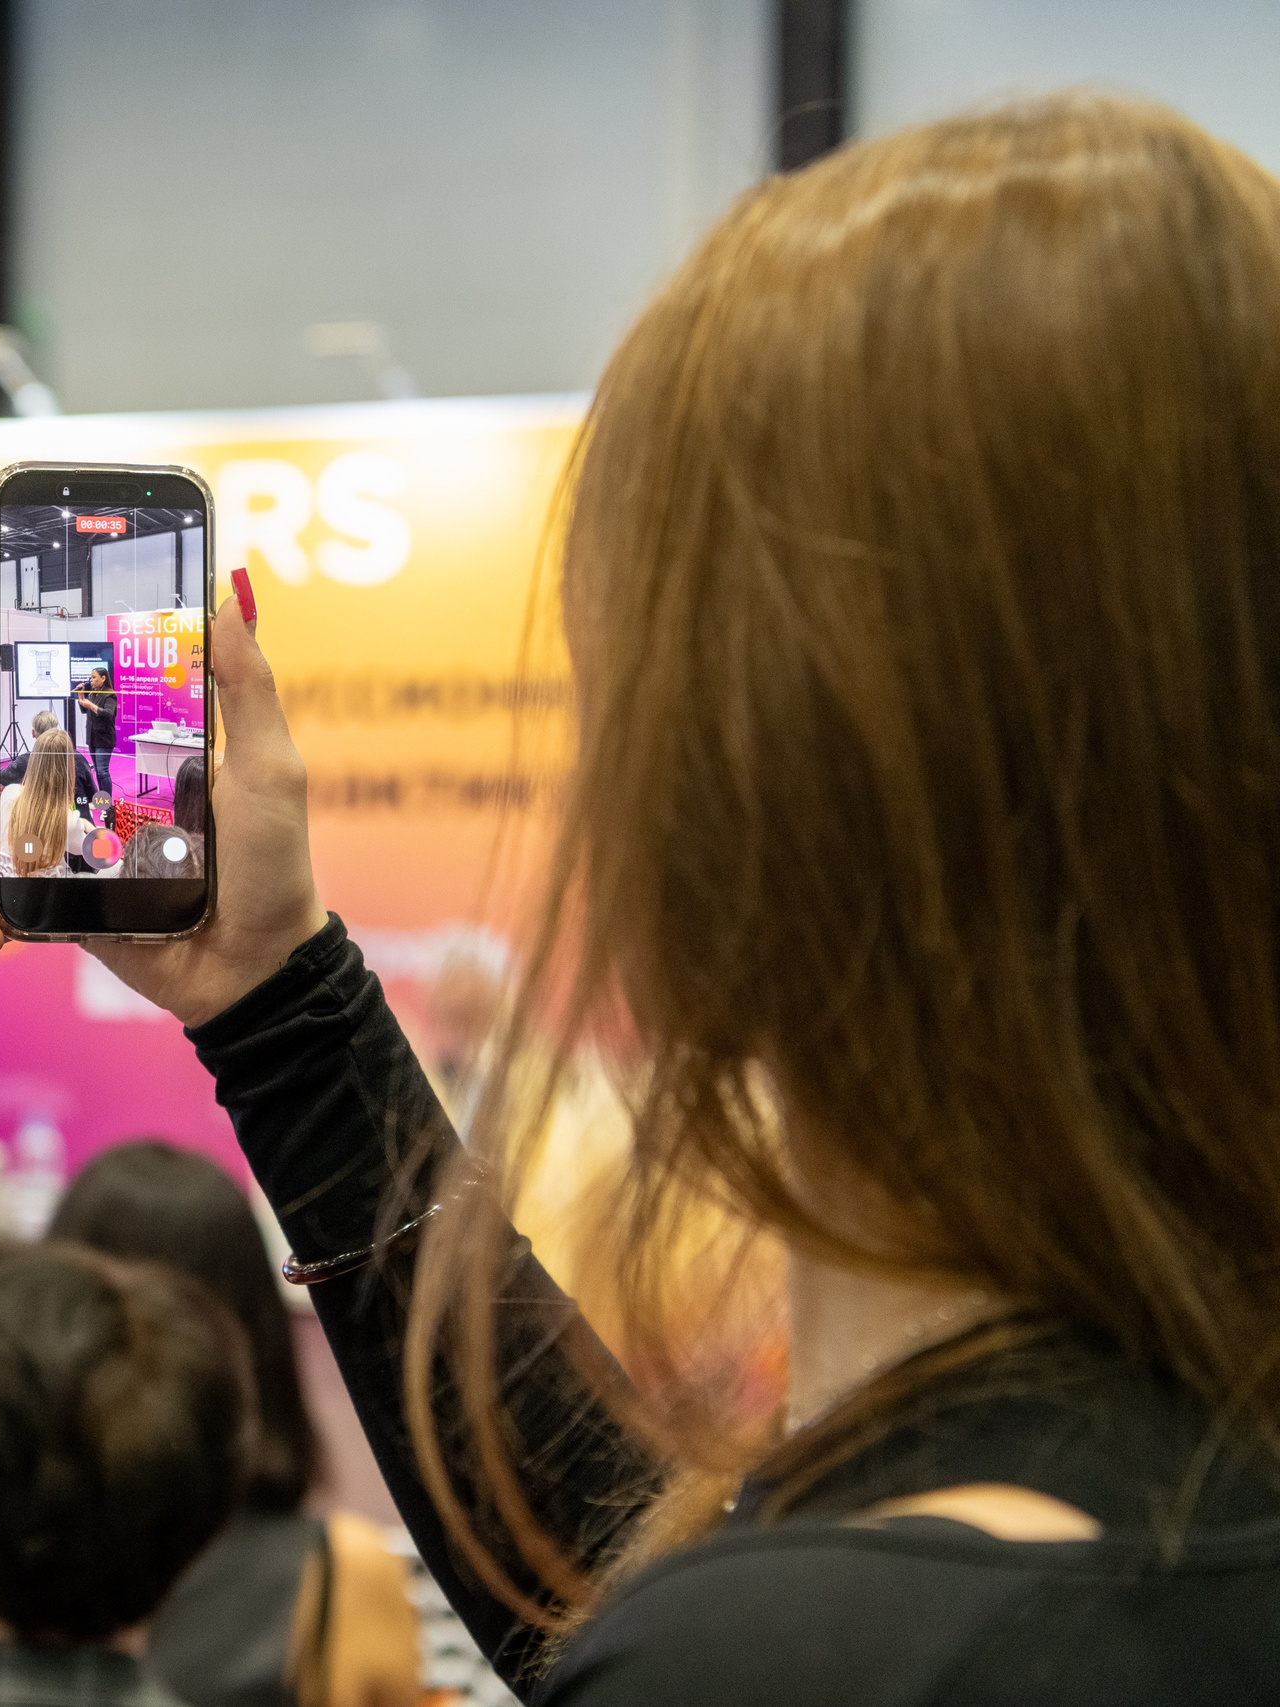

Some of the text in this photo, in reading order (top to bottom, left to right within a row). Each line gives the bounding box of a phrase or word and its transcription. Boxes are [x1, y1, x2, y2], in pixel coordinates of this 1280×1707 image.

[80, 520, 122, 530] 00:00:35
[119, 614, 204, 635] DESIGNE
[119, 636, 178, 668] CLUB
